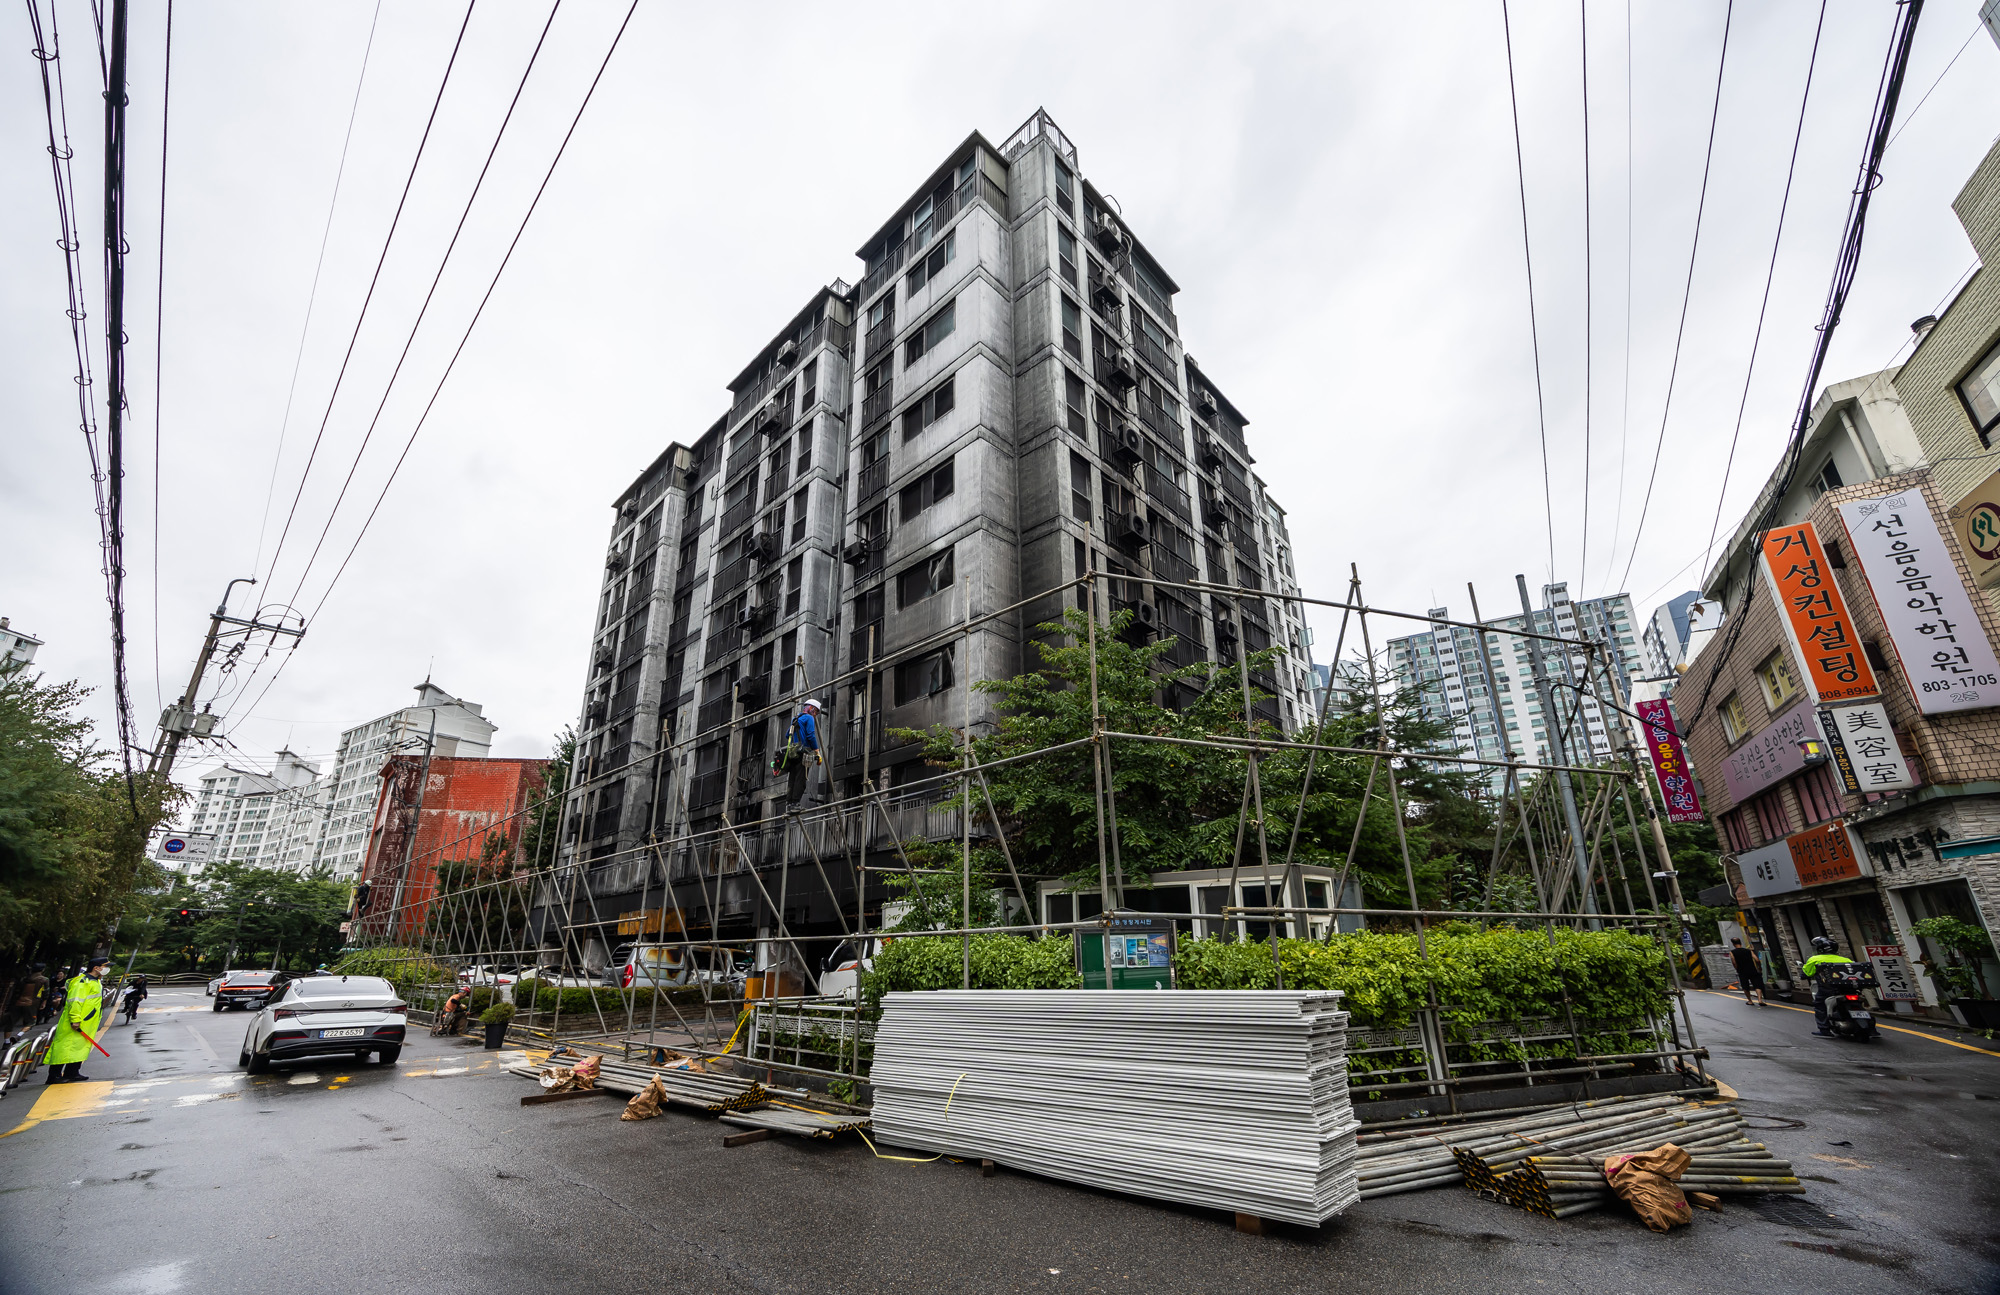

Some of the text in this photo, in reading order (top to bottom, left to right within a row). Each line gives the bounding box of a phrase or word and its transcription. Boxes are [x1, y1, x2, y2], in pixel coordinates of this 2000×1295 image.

[1872, 513, 1974, 675] 선음음악학원
[1770, 529, 1860, 684] 거성컨설팅
[1818, 684, 1878, 700] 808-8944
[1921, 673, 1998, 693] 803-1705
[1950, 690, 1980, 703] 2층
[1846, 710, 1903, 785] 美容室
[1671, 812, 1702, 822] 803-1705
[1791, 826, 1850, 869] 거성컨설팅
[1801, 865, 1846, 883] 808-8944
[1868, 946, 1899, 955] 거성
[1879, 958, 1909, 992] 부동산
